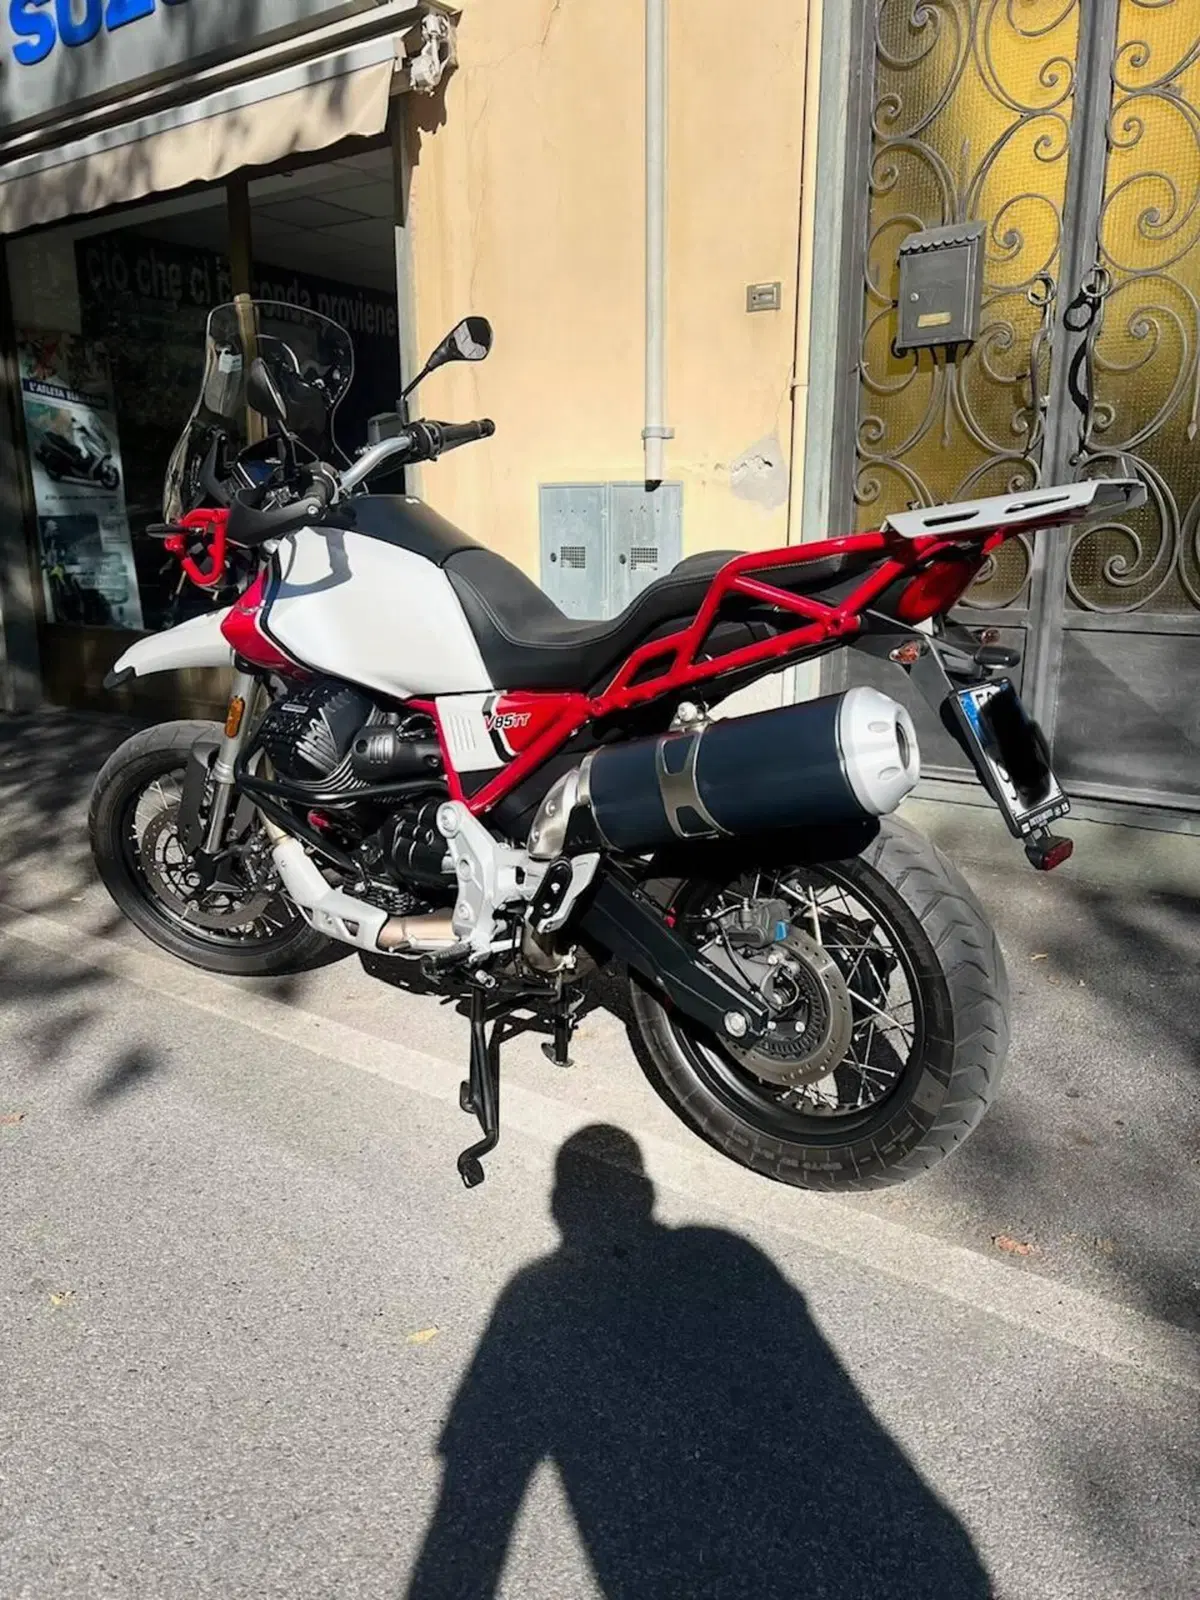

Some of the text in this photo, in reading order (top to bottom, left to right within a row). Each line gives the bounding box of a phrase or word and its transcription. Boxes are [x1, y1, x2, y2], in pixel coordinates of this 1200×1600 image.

[9, 0, 190, 66] SU
[86, 239, 129, 290] ciò
[133, 247, 182, 301] che
[216, 270, 312, 325] conda
[317, 291, 398, 337] proviene
[483, 712, 533, 732] V85TT
